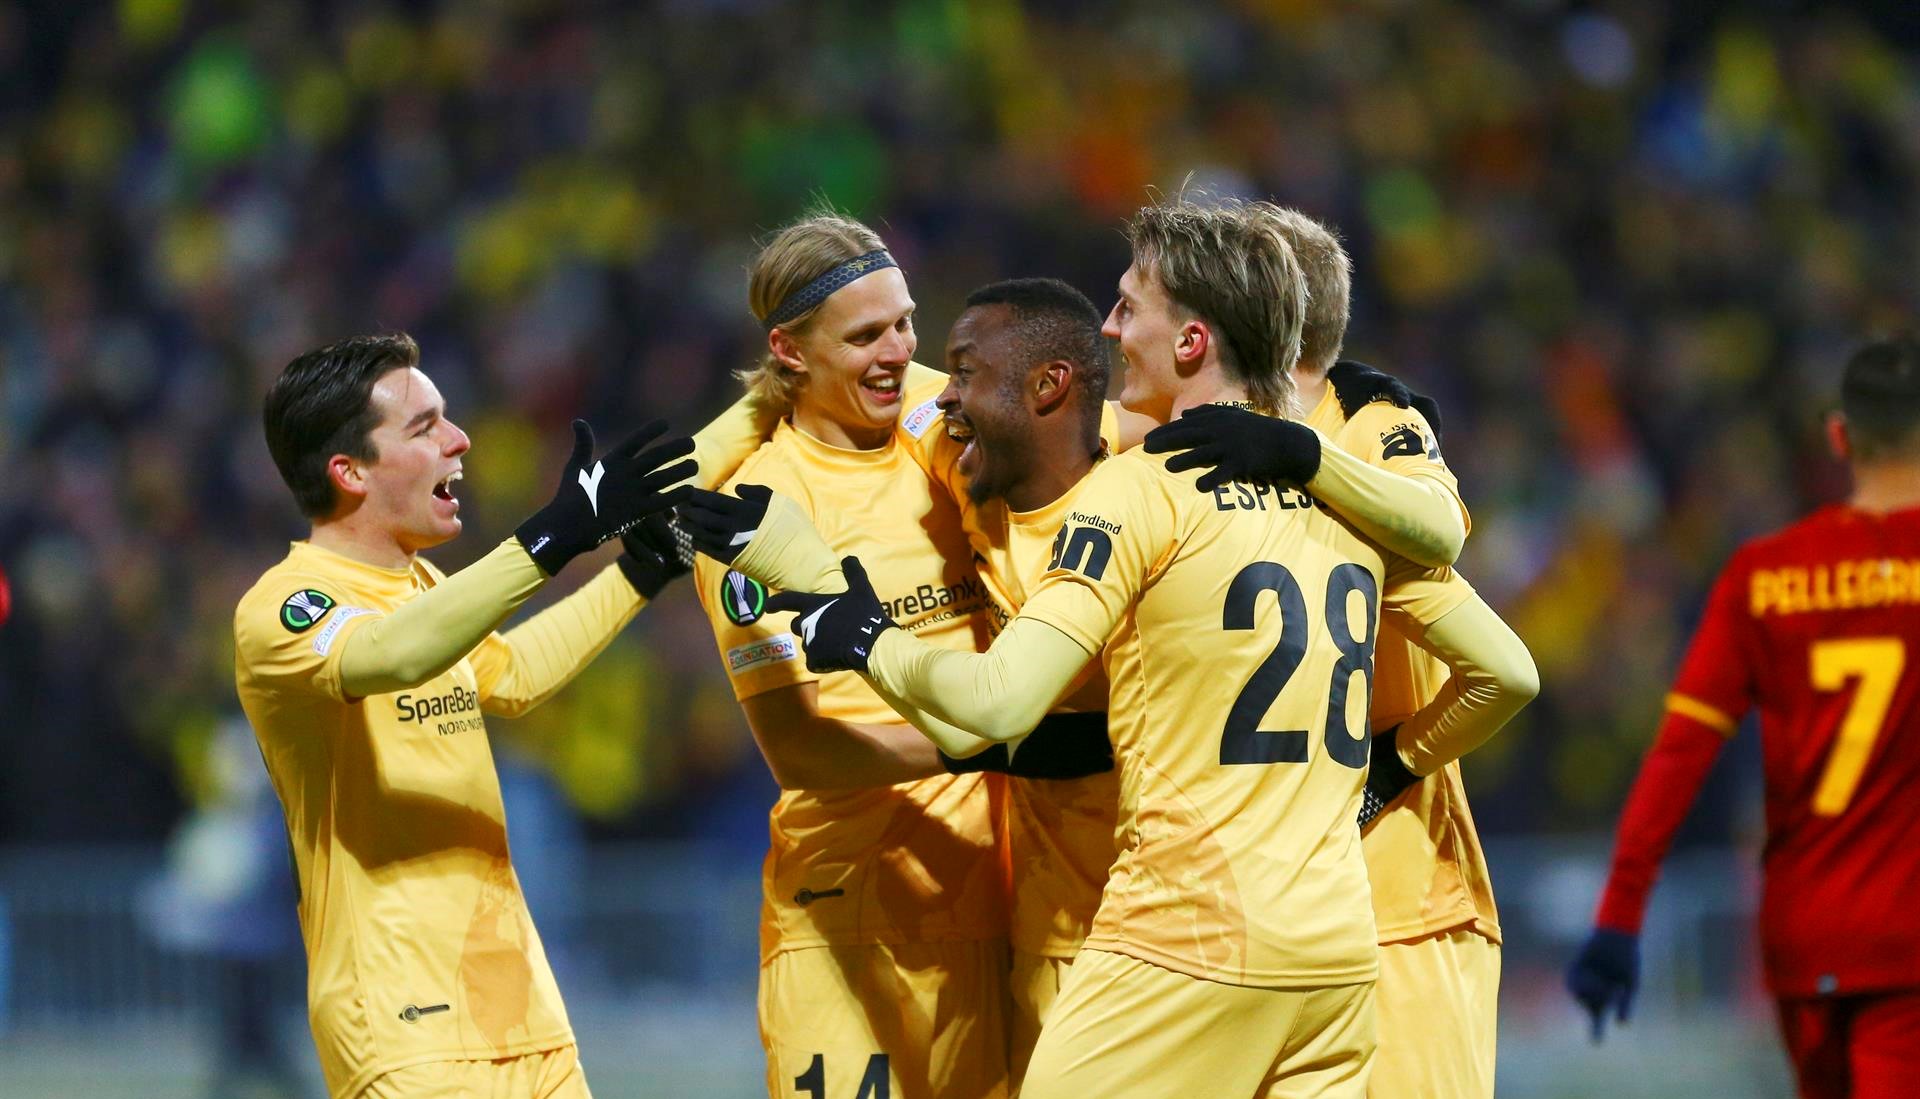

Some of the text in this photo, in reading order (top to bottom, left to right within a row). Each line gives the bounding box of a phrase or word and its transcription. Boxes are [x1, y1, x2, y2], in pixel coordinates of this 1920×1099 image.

[1070, 511, 1122, 536] Nordland
[880, 575, 978, 618] areBank
[1219, 560, 1378, 769] 28
[396, 686, 478, 725] SpareBan
[437, 717, 484, 737] NORD-NOR
[1810, 637, 1905, 817] 7
